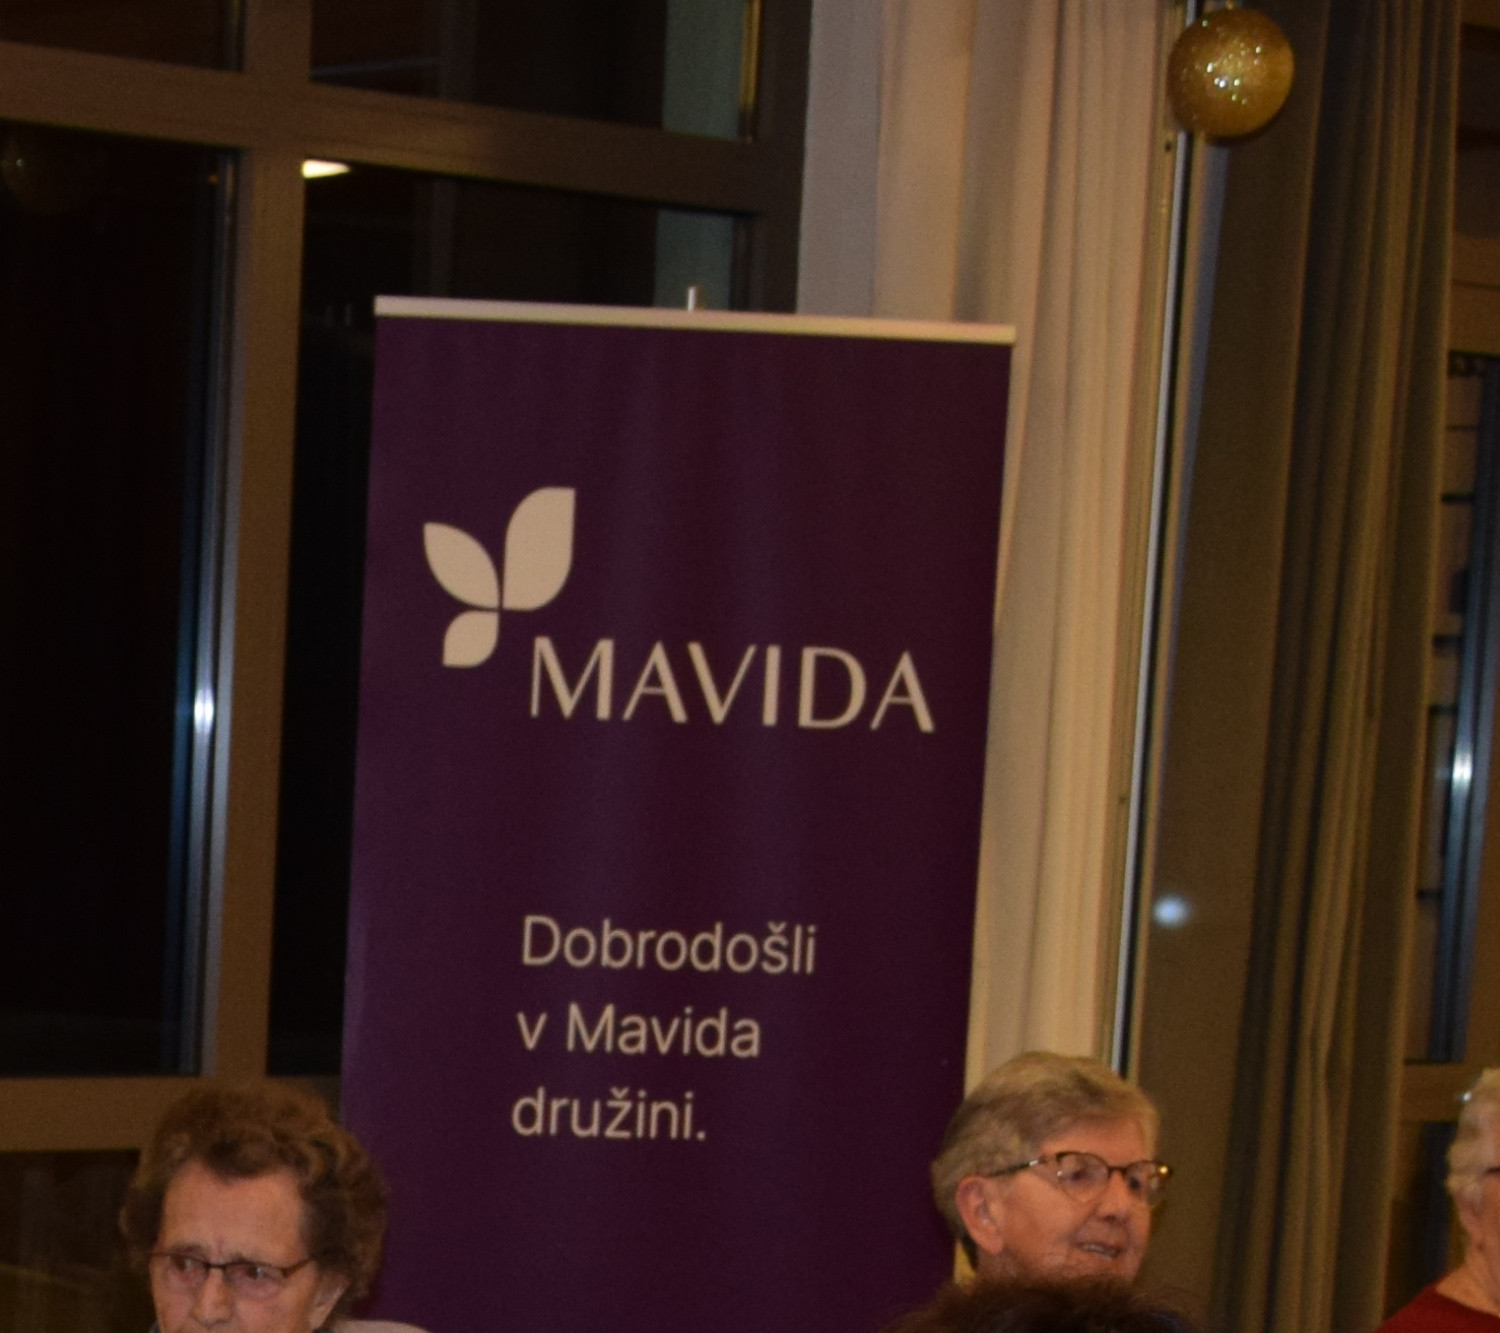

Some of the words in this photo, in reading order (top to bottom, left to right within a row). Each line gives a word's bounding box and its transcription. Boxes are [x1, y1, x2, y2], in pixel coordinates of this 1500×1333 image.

[530, 635, 935, 733] MAVIDA
[522, 914, 817, 975] Dobrodošli
[516, 1012, 547, 1051] v
[566, 1002, 761, 1058] Mavida
[511, 1086, 707, 1140] družini.
